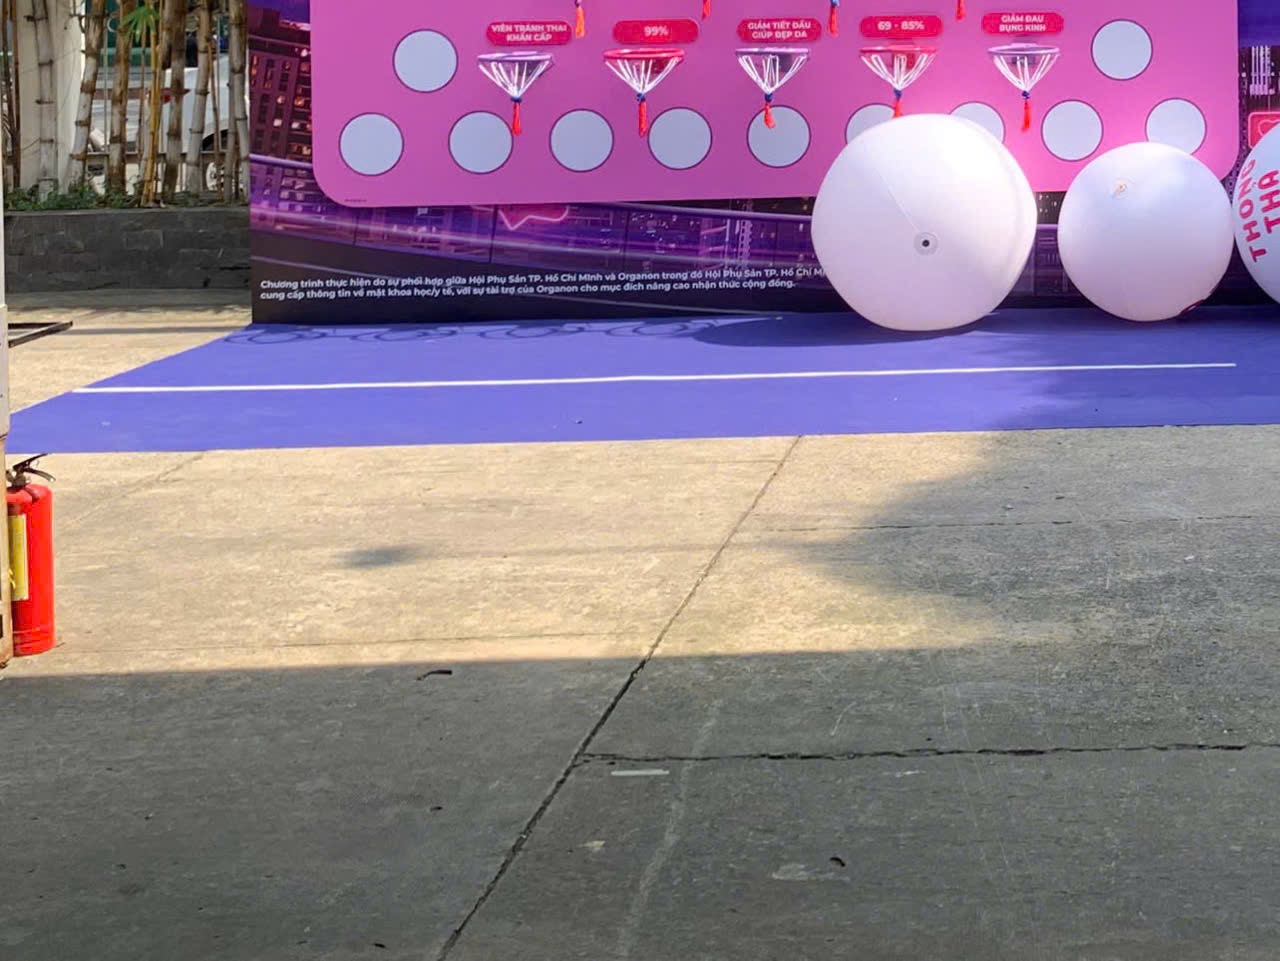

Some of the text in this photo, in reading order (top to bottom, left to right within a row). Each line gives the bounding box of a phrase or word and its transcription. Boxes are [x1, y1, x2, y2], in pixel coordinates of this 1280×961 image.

[546, 23, 567, 31] THAI
[643, 25, 669, 37] 99%
[878, 20, 892, 31] 69
[901, 19, 925, 31] 85%
[1025, 23, 1046, 32] KINH
[260, 279, 298, 290] Chương
[301, 278, 323, 288] trình
[326, 278, 348, 288] thực
[350, 277, 371, 287] hiện
[373, 277, 385, 286] do
[388, 278, 399, 288] sự
[401, 276, 422, 287] phối
[425, 276, 443, 287] hợp
[445, 275, 466, 286] giữa
[469, 274, 485, 285] Hội
[487, 274, 507, 285] Phụ
[509, 273, 526, 283] Sản
[528, 274, 543, 283] TP.
[545, 272, 558, 282] Hồ
[561, 272, 576, 282] Chí
[579, 272, 602, 282] Minh
[605, 272, 616, 281] và
[618, 271, 660, 282] Organon
[662, 271, 688, 281] trong
[705, 269, 721, 280] Hội
[723, 269, 742, 279] Phụ
[744, 268, 761, 278] Sản
[764, 268, 778, 277] TP.
[796, 267, 812, 277] Chí
[260, 291, 285, 301] cung
[287, 289, 305, 300] cấp
[307, 289, 335, 299] thông
[337, 288, 351, 297] tin
[367, 288, 385, 298] mặt
[388, 287, 411, 297] khoa
[414, 287, 440, 298] học/y
[457, 285, 471, 295] với
[473, 286, 484, 297] sự
[486, 285, 499, 295] tài
[501, 285, 515, 295] trợ
[517, 284, 534, 294] của
[536, 284, 578, 295] Organon
[580, 283, 598, 293] cho
[600, 284, 621, 294] mục
[623, 282, 644, 292] đích
[646, 281, 671, 292] nâng
[673, 281, 690, 290] cao
[692, 279, 716, 291] nhận
[718, 279, 741, 289] thức
[743, 279, 766, 290] cộng
